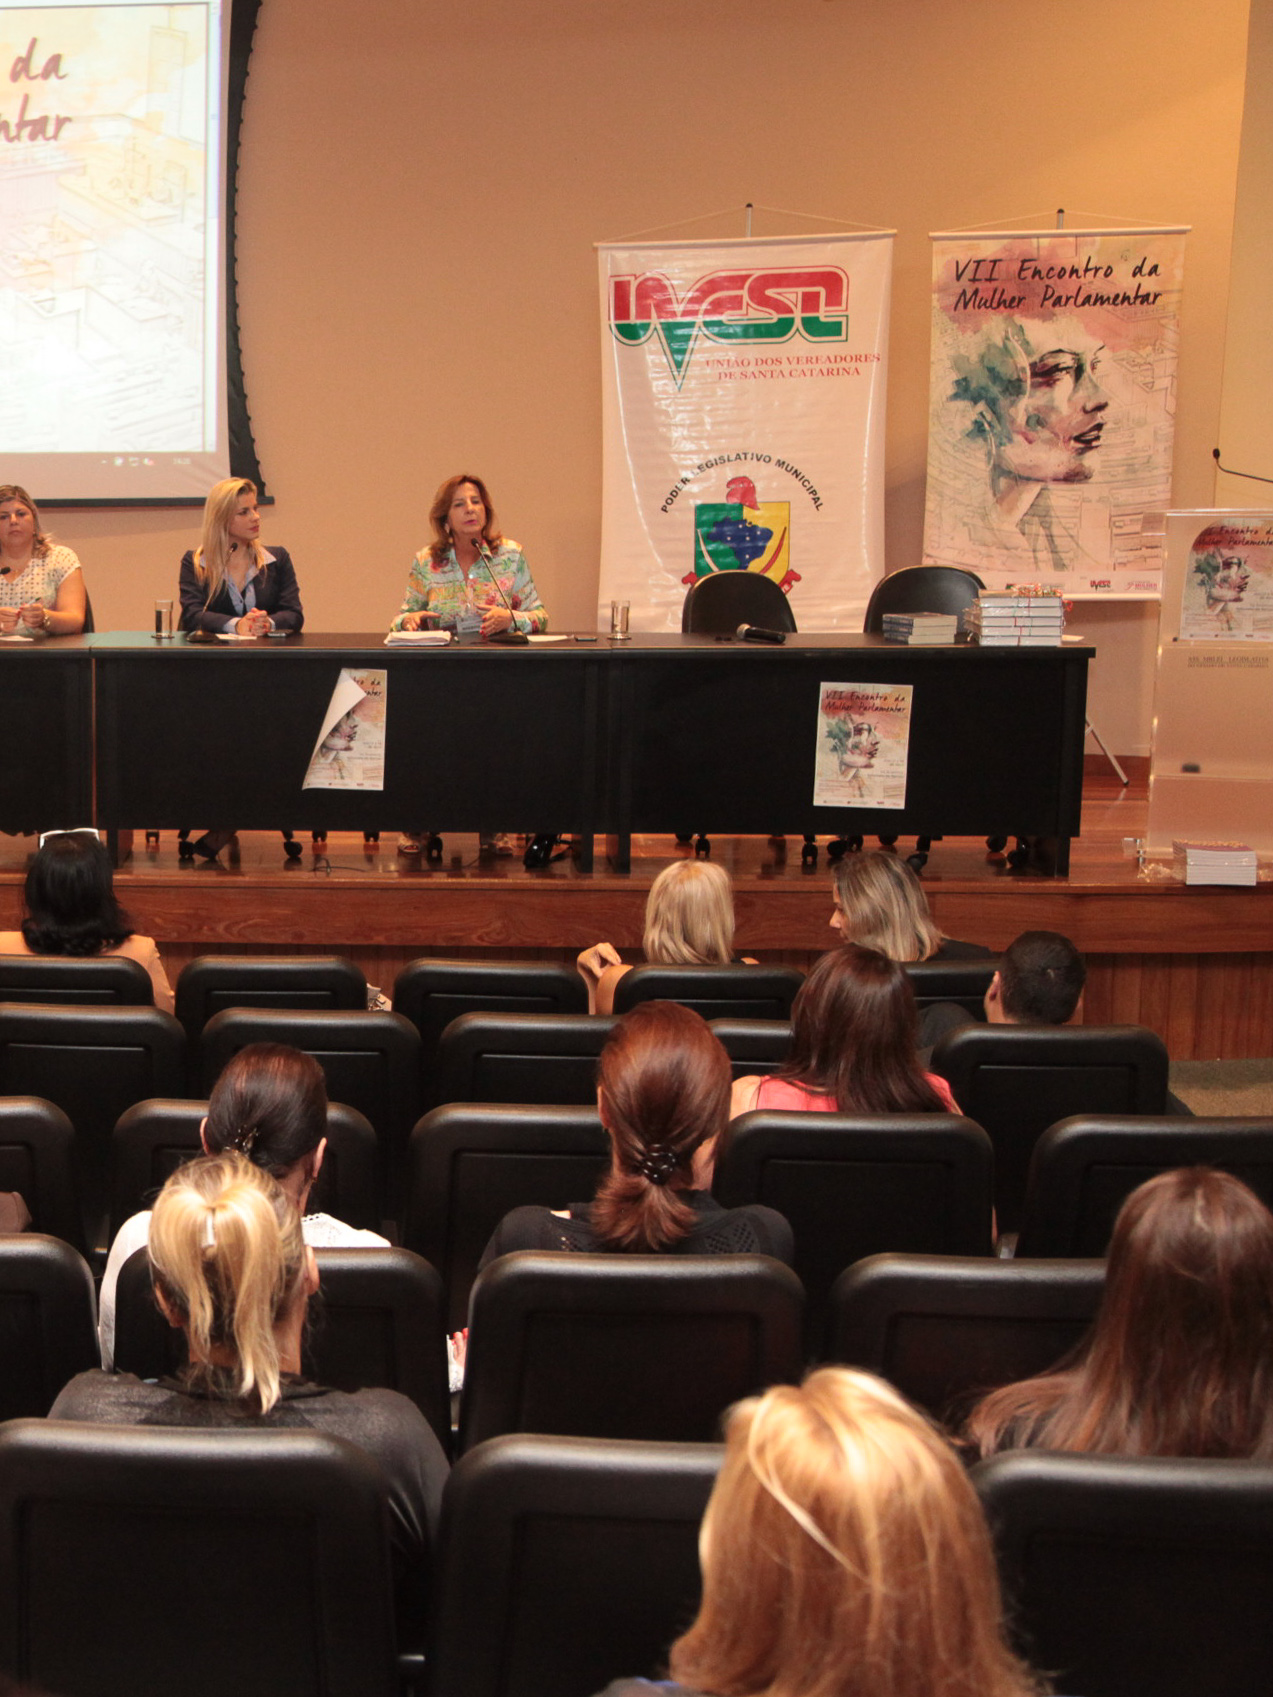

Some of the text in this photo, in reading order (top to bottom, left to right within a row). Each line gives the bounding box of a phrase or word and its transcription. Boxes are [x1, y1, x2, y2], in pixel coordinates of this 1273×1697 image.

[9, 36, 69, 84] da
[954, 255, 1162, 283] VII Encontro da
[953, 282, 1163, 312] Mulher Parlamentar
[717, 366, 861, 381] DE SANTA CATARINA
[754, 356, 783, 367] DOS
[785, 352, 881, 366] VEREADORES
[661, 476, 691, 514] PODER
[774, 458, 825, 512] MUNICIPAL
[850, 691, 888, 702] Encontro
